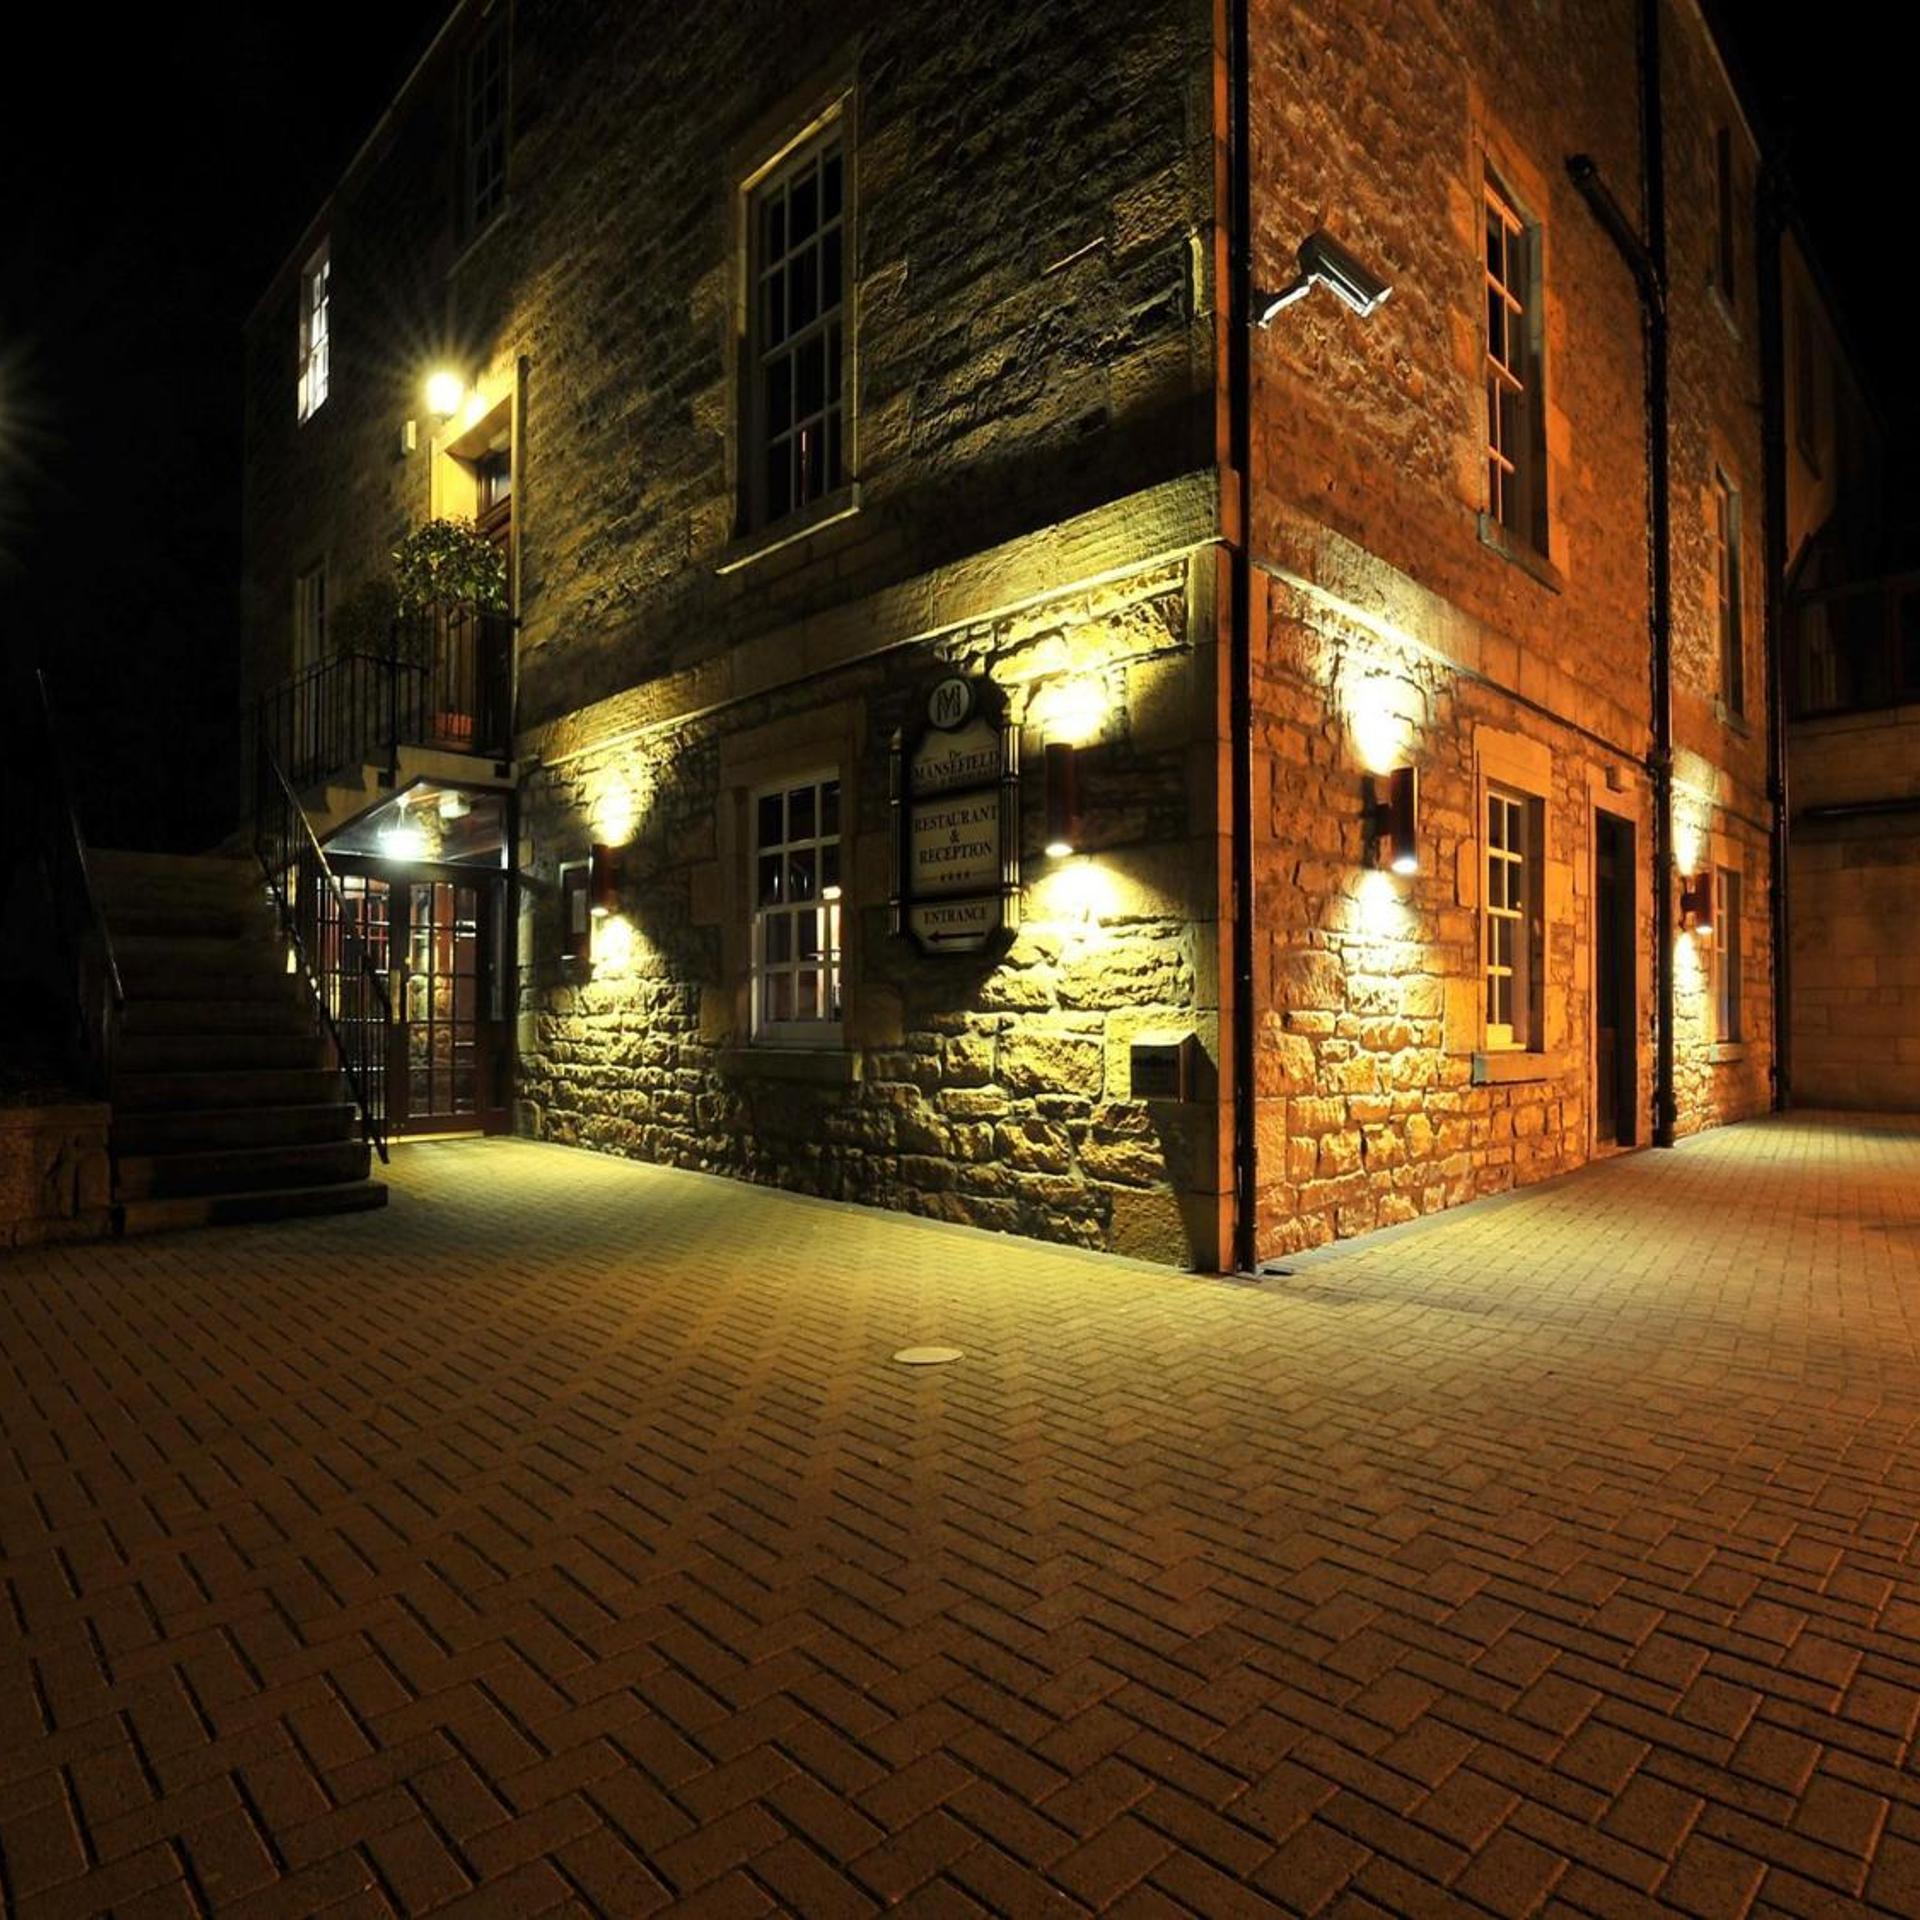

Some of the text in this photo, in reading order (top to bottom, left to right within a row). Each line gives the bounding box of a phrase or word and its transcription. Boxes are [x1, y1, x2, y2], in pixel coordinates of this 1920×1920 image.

[914, 805, 997, 832] RESTAURANT
[949, 829, 960, 843] &
[919, 842, 992, 864] RECEPTION
[923, 907, 986, 925] ENTRANCE
